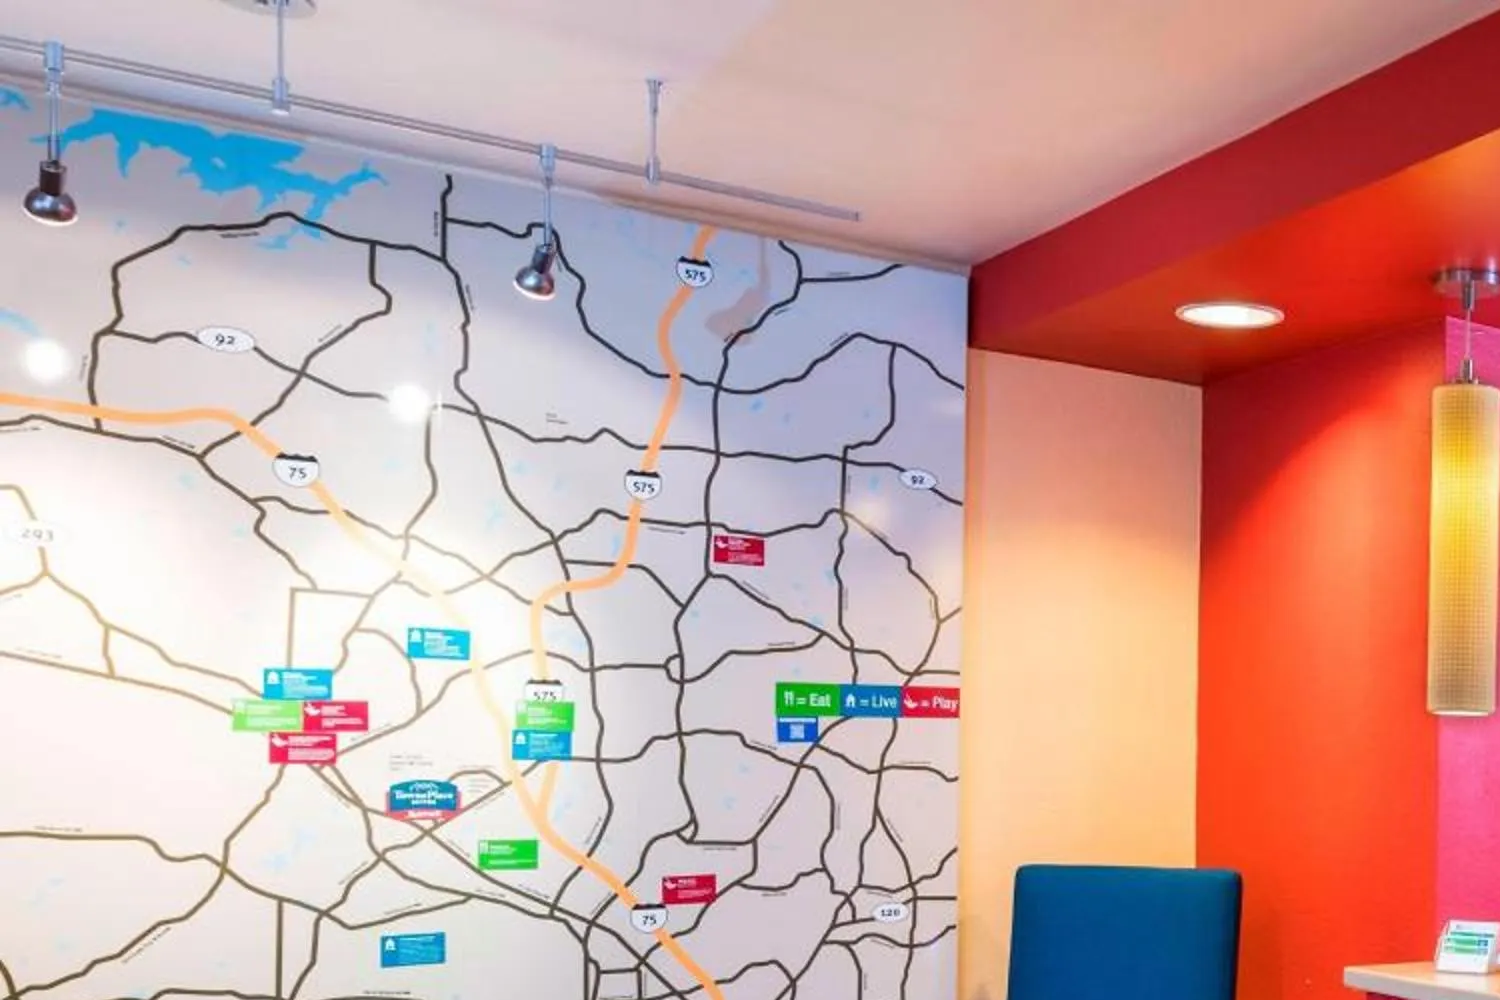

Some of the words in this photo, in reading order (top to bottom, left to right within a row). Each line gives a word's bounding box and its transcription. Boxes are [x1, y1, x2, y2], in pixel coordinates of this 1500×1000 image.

[684, 268, 708, 282] 575
[215, 334, 236, 346] 92
[289, 466, 308, 479] 75
[632, 481, 656, 493] 575
[533, 691, 557, 701] 575
[808, 693, 832, 707] Eat
[871, 694, 898, 709] Live
[931, 695, 959, 713] Play
[880, 908, 901, 918] 120
[642, 915, 657, 927] 75
